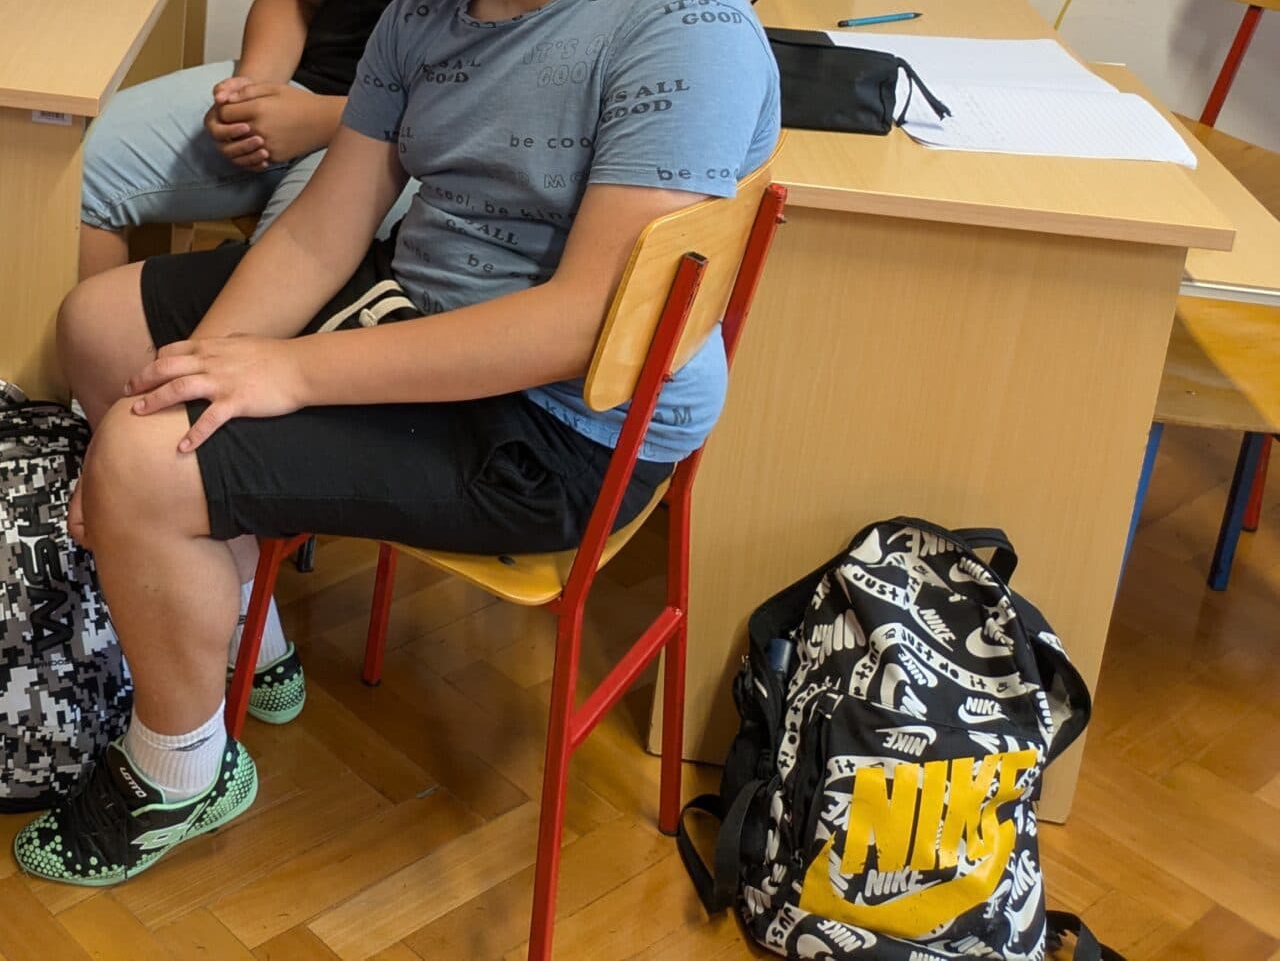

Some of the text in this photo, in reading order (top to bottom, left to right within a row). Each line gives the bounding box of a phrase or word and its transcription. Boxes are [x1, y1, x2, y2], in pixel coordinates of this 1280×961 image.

[681, 11, 743, 25] GOOD
[537, 60, 592, 88] GOO
[635, 78, 691, 100] ALL
[509, 135, 595, 150] be coo
[656, 166, 692, 182] be
[467, 254, 495, 274] be
[919, 607, 957, 643] NIKE
[964, 695, 1003, 716] NIKE
[881, 733, 932, 758] NIKE
[119, 766, 148, 799] LOTTO
[840, 748, 1038, 875] NIKE
[865, 865, 924, 898] NIKE
